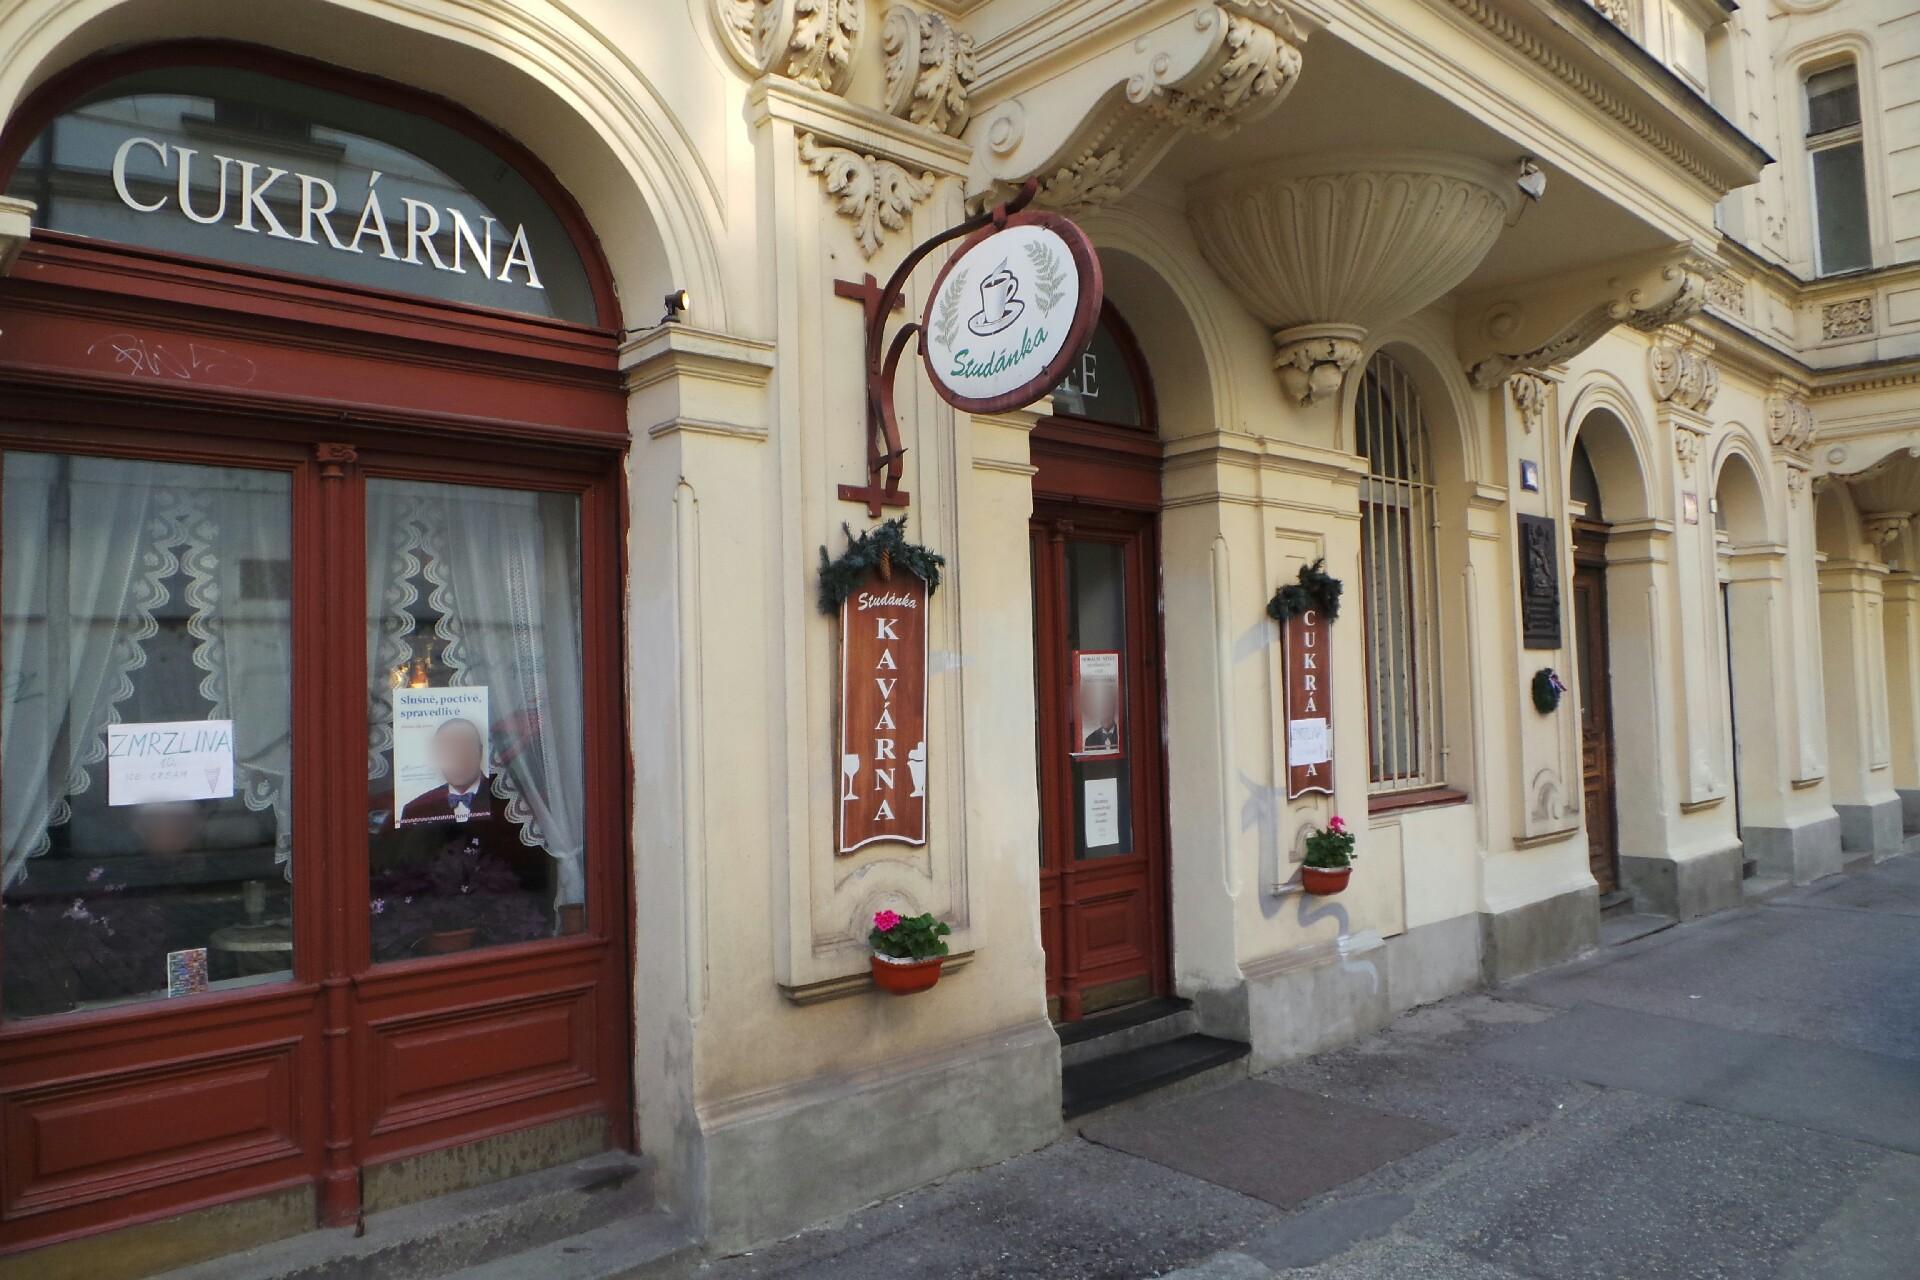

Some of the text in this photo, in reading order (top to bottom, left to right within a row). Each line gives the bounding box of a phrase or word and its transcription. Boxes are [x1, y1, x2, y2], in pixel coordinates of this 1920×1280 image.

[112, 137, 544, 289] CUKRÁRNA
[950, 326, 1049, 379] Studánka
[857, 591, 918, 611] Studánka
[109, 729, 231, 757] ZMRZLINA
[873, 617, 900, 821] KAVÁRNA
[1304, 610, 1318, 777] CUKRÁA
